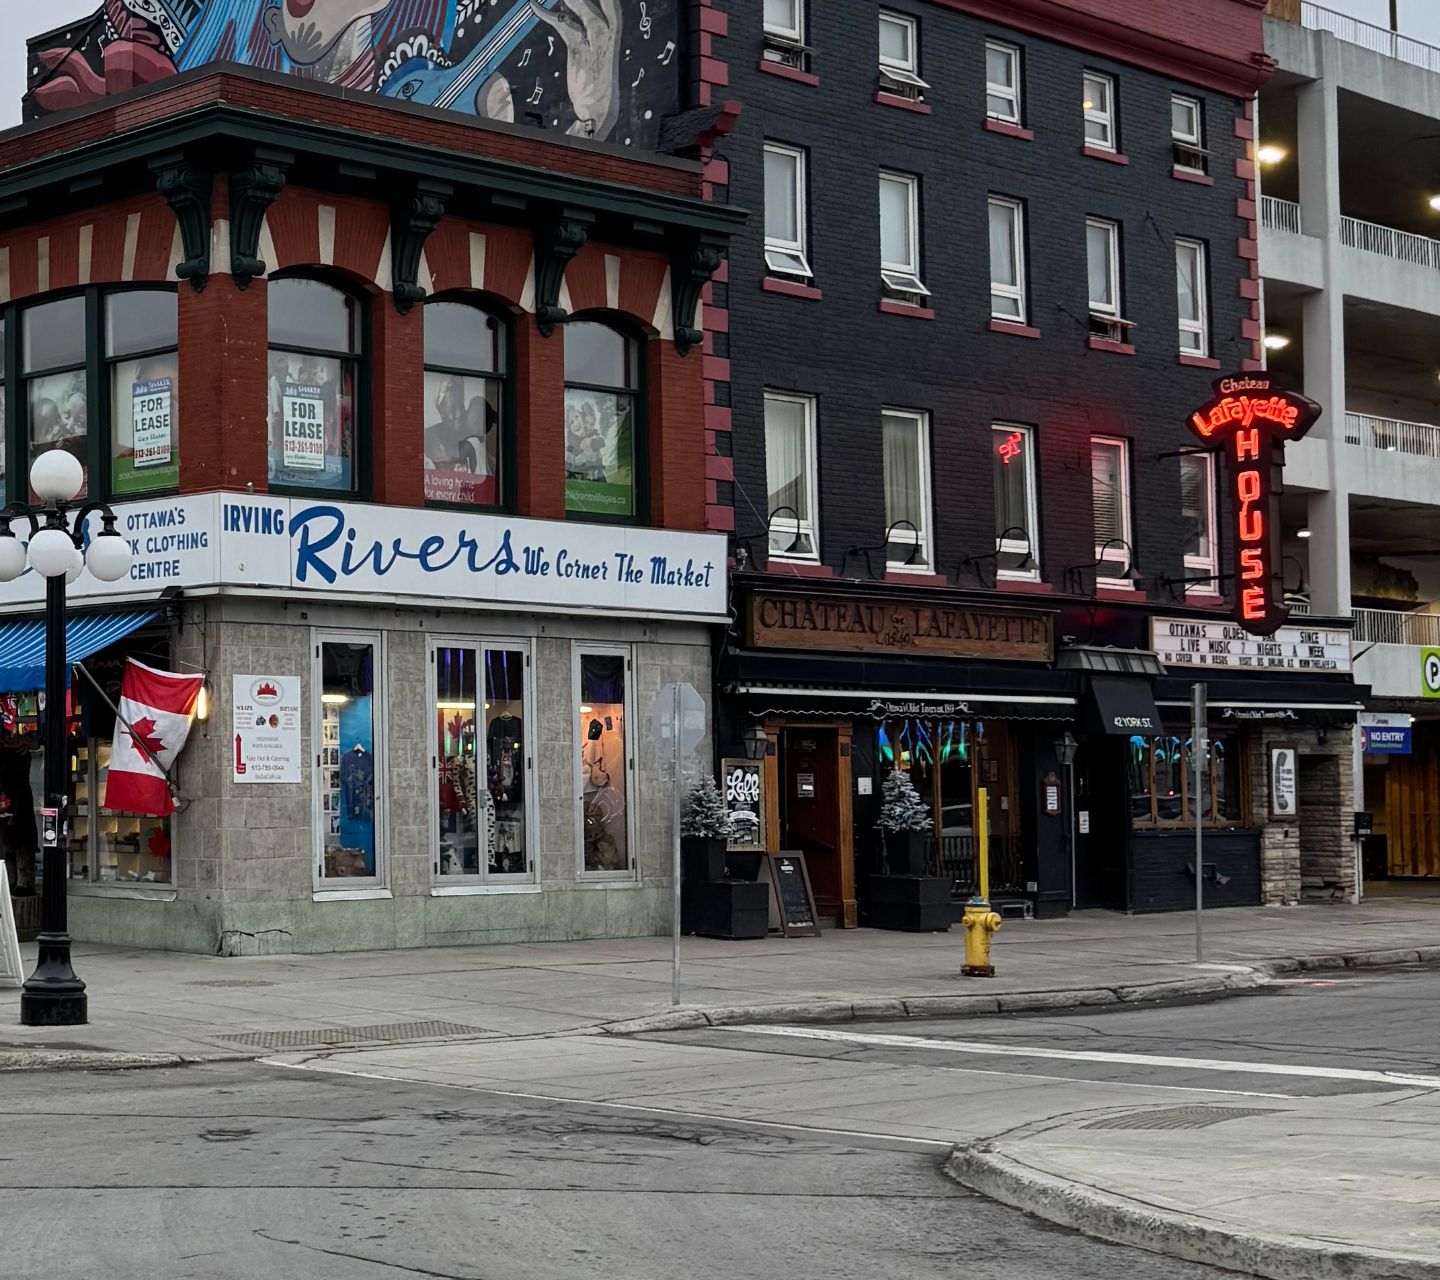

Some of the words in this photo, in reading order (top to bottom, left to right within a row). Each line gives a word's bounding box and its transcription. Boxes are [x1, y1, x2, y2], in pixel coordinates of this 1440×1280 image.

[1220, 378, 1270, 393] Chateau
[140, 397, 163, 413] FOR
[291, 401, 316, 420] FOR
[135, 414, 169, 432] LEASE
[1192, 396, 1299, 436] Lafayette
[285, 420, 322, 440] LEASE
[431, 475, 453, 489] loving
[454, 478, 475, 489] home
[435, 490, 457, 501] every
[457, 491, 475, 502] child
[127, 506, 185, 530] OTTAWA'S
[1235, 428, 1266, 620] HOUSE
[146, 532, 208, 554] CLOTHING
[223, 504, 284, 535] IRVING
[289, 505, 520, 584] Rivers
[523, 546, 550, 577] We
[556, 549, 608, 580] Corner
[614, 552, 643, 584] The
[650, 556, 714, 587] Market
[130, 560, 180, 580] CENTRE
[912, 608, 1043, 643] LAFAYETTE
[1169, 623, 1207, 638] OTTAWAS
[1223, 626, 1248, 641] OLDEST
[1300, 631, 1320, 645] SINCE
[1164, 652, 1172, 662] NO
[1175, 652, 1192, 664] COVER
[1199, 654, 1207, 664] NO
[1180, 638, 1200, 653] LIVE
[1208, 640, 1231, 654] MUSIC
[1241, 642, 1246, 655] 7
[1257, 642, 1282, 656] NIGHTS
[1292, 644, 1298, 658] A
[1308, 645, 1325, 659] WEEK
[1122, 717, 1141, 728] YORK
[1141, 717, 1154, 728] ST.
[1370, 731, 1381, 741] NO
[1382, 732, 1405, 742] ENTRY
[727, 768, 760, 802] Laff
